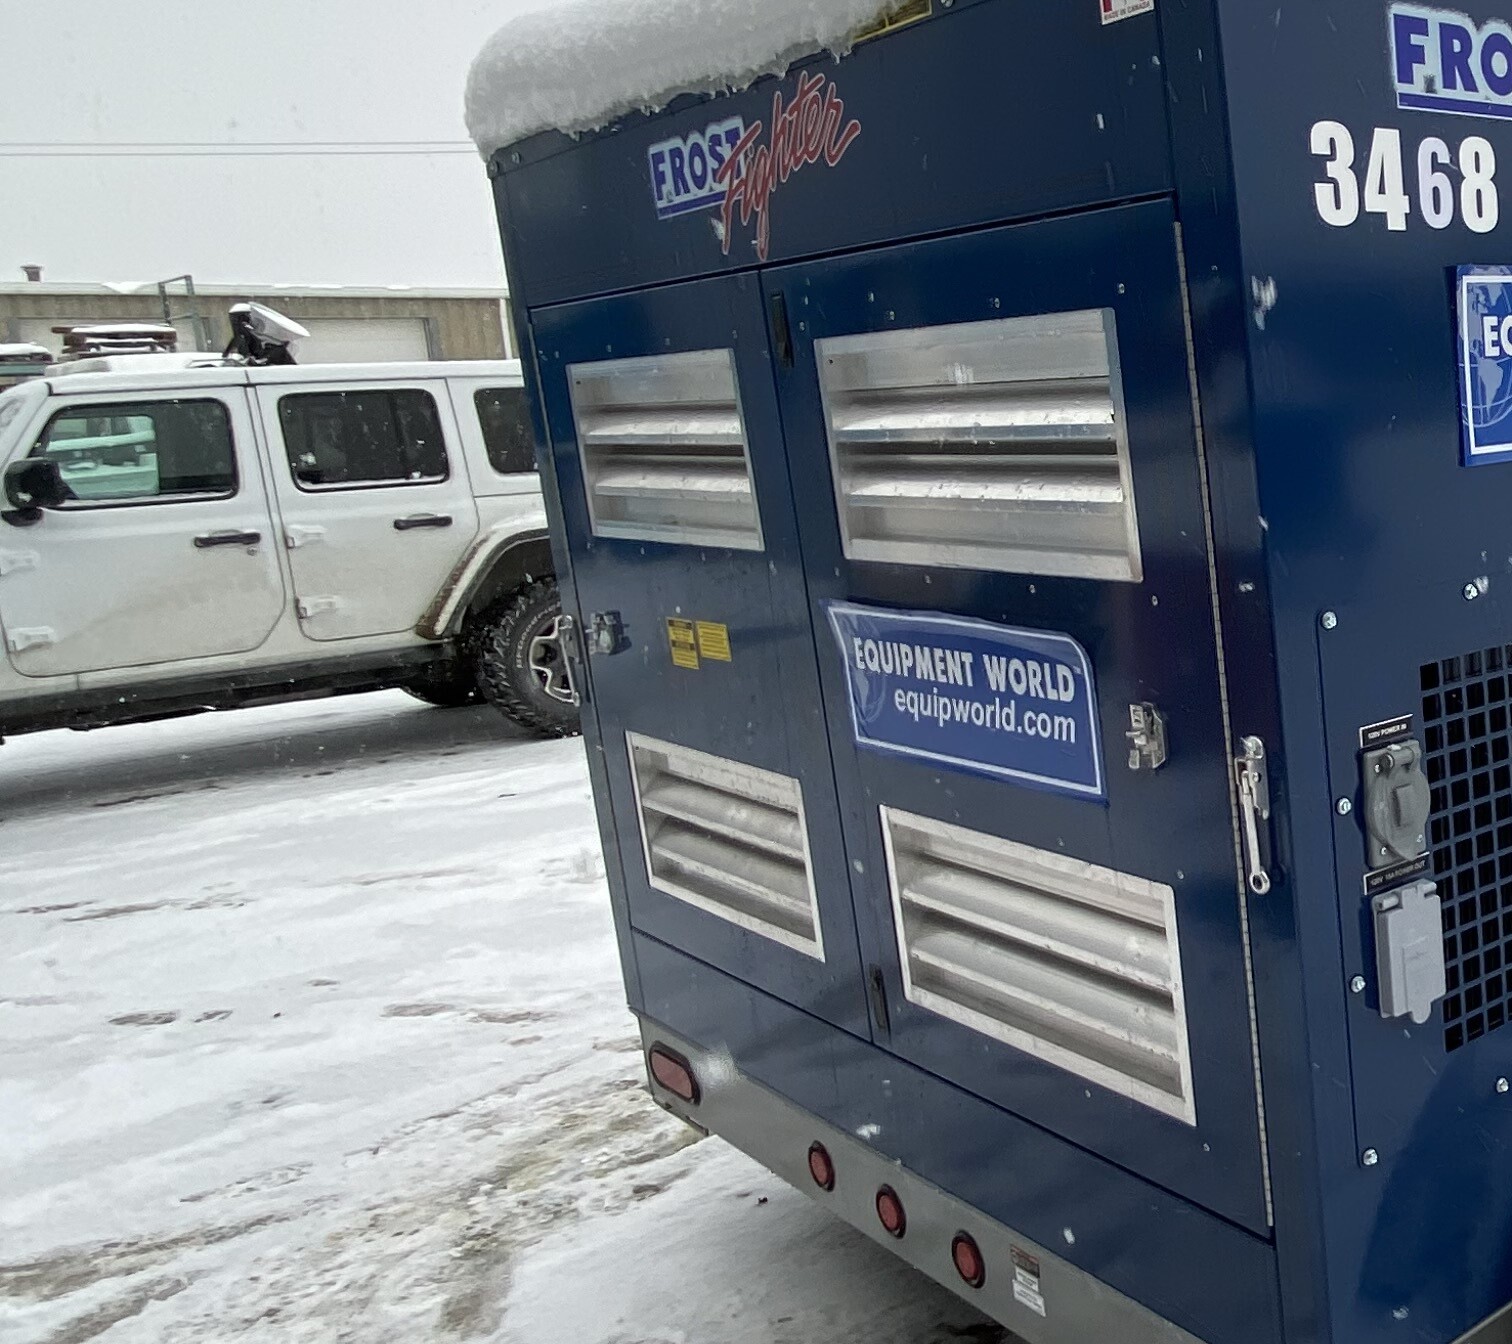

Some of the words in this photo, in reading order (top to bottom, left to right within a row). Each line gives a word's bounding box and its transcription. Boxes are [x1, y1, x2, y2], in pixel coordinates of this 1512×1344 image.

[650, 126, 743, 202] FROST
[715, 69, 862, 262] Fighter
[1310, 120, 1499, 235] 3468
[852, 636, 974, 688] EQUIPMENT
[982, 653, 1075, 703] WORLD
[894, 686, 1076, 744] equipworld.com
